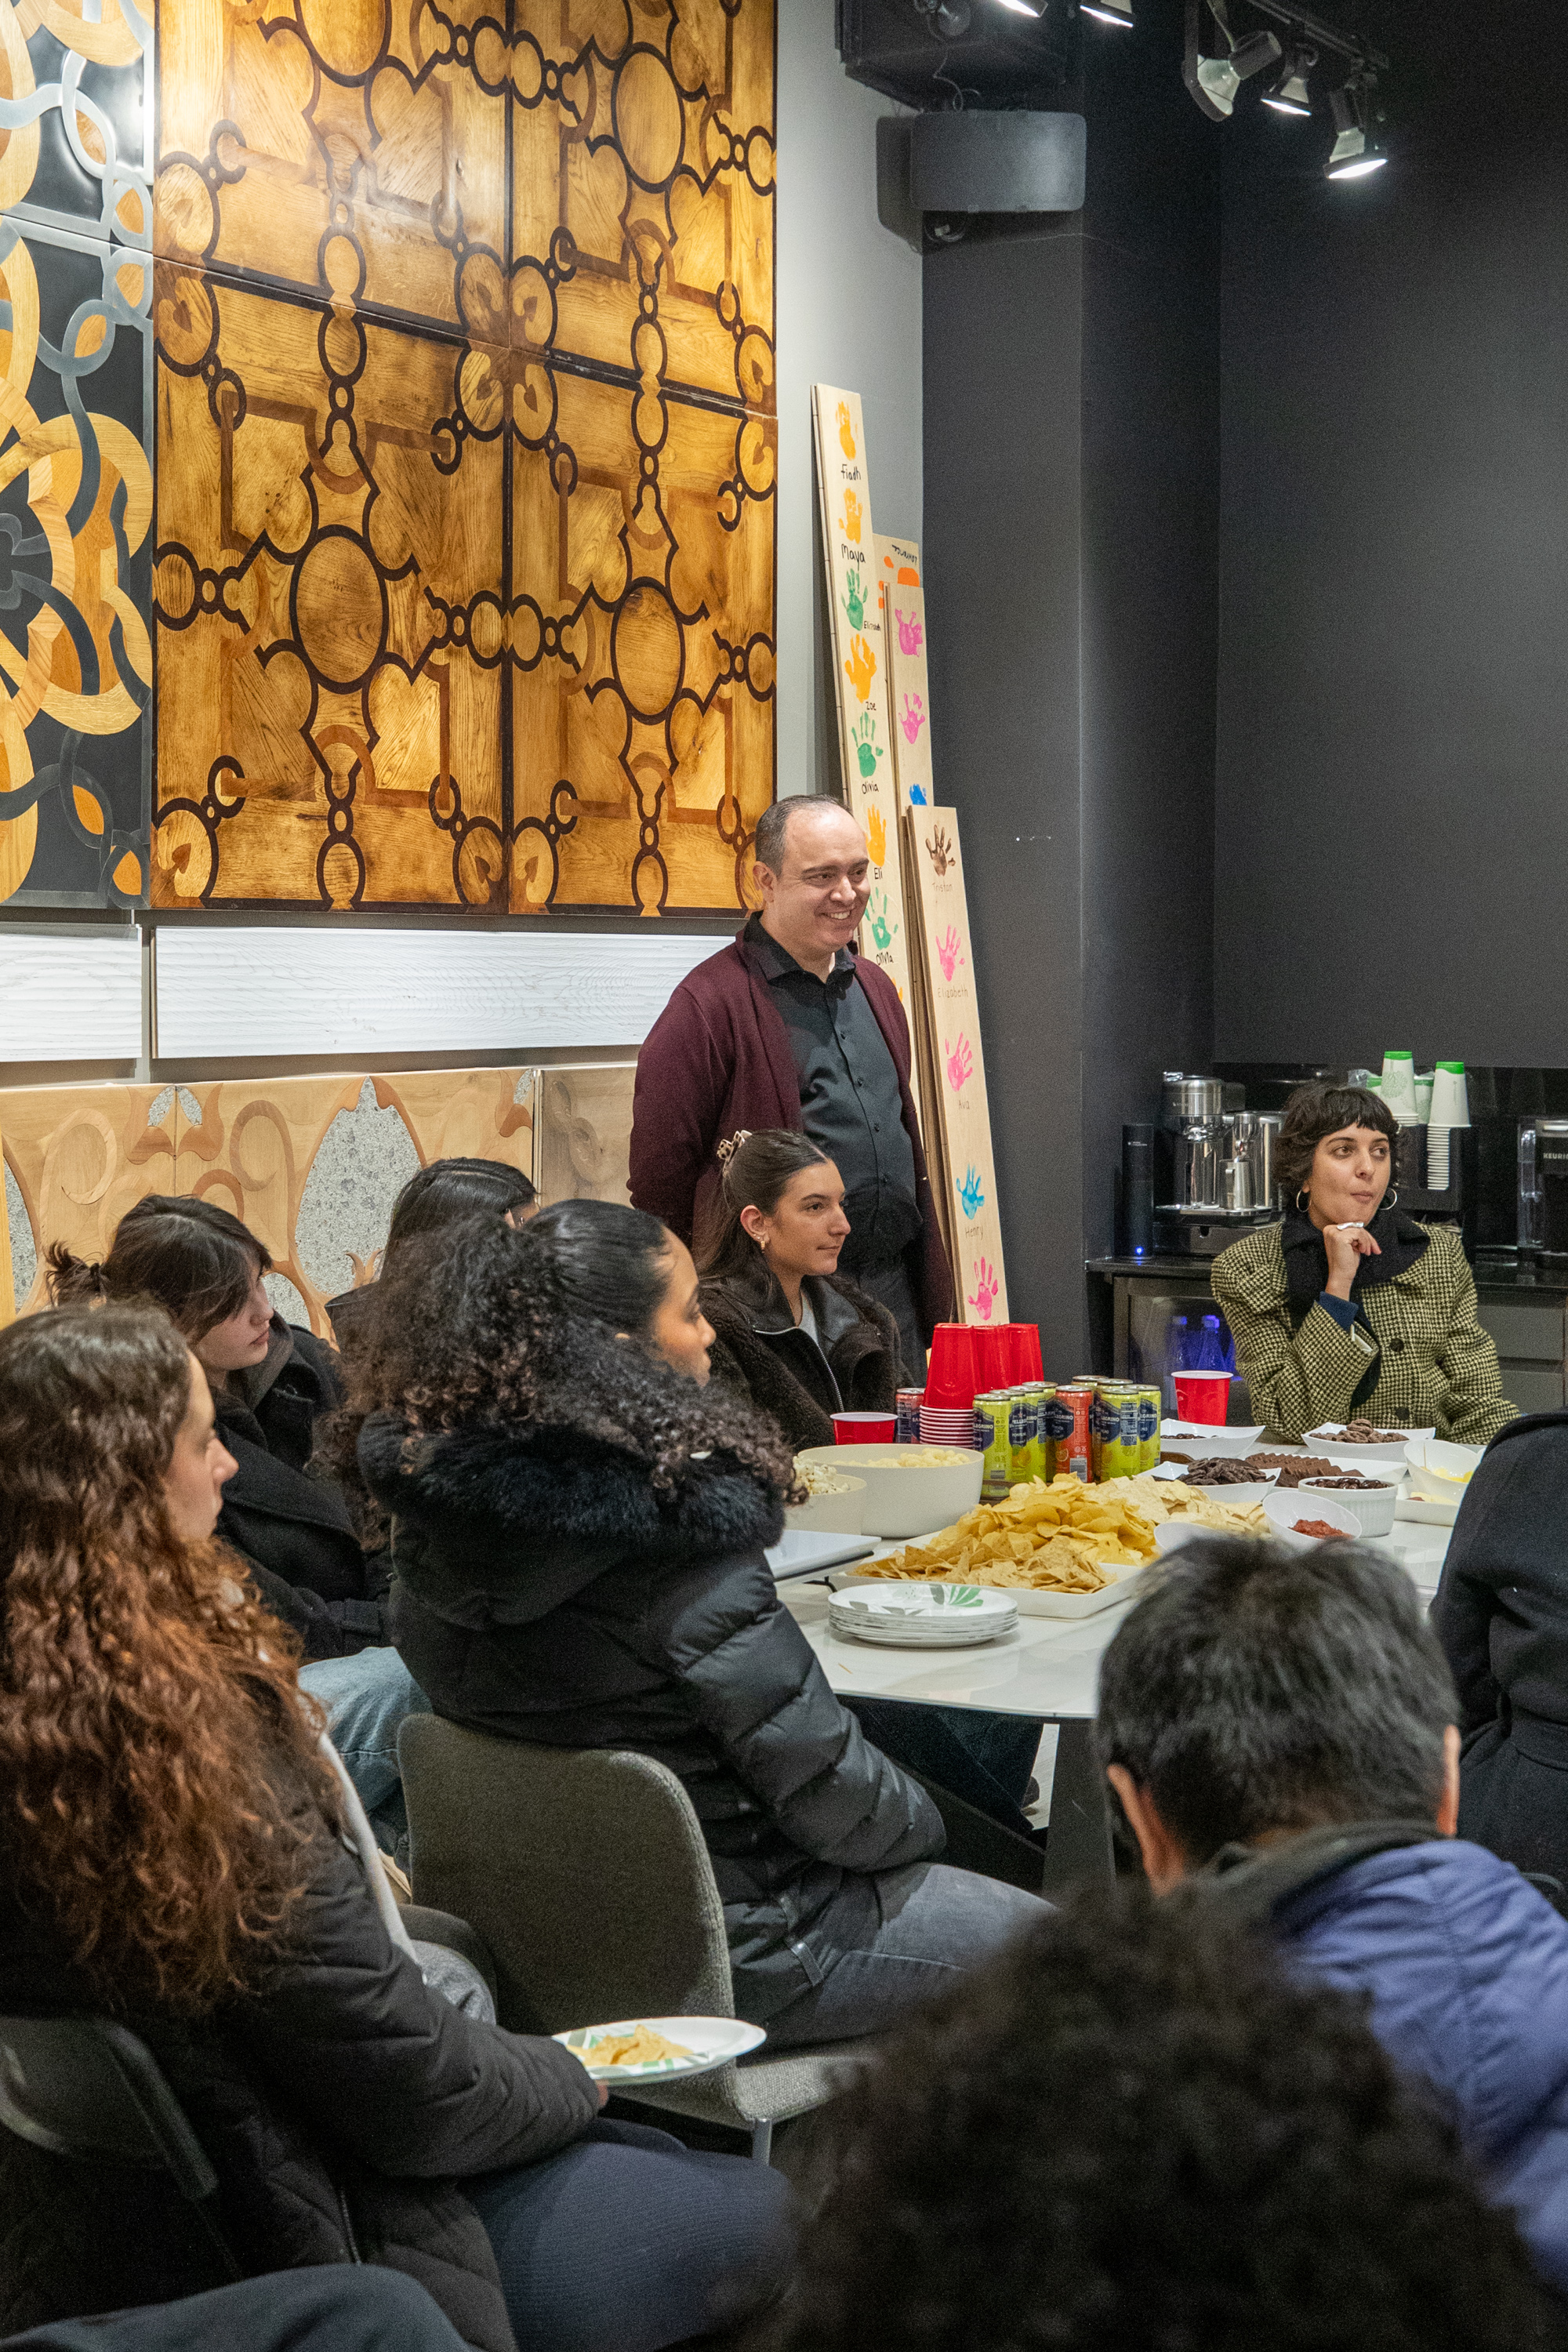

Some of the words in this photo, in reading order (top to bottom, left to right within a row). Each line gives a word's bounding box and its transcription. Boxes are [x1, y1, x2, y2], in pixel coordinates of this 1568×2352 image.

[841, 463, 861, 481] Fiadh
[841, 543, 866, 572] Maya
[873, 866, 883, 880] Eli
[931, 879, 953, 892] Tristan
[937, 984, 968, 998] Elizabeth
[958, 1099, 970, 1110] Ava
[964, 1225, 983, 1241] Henry
